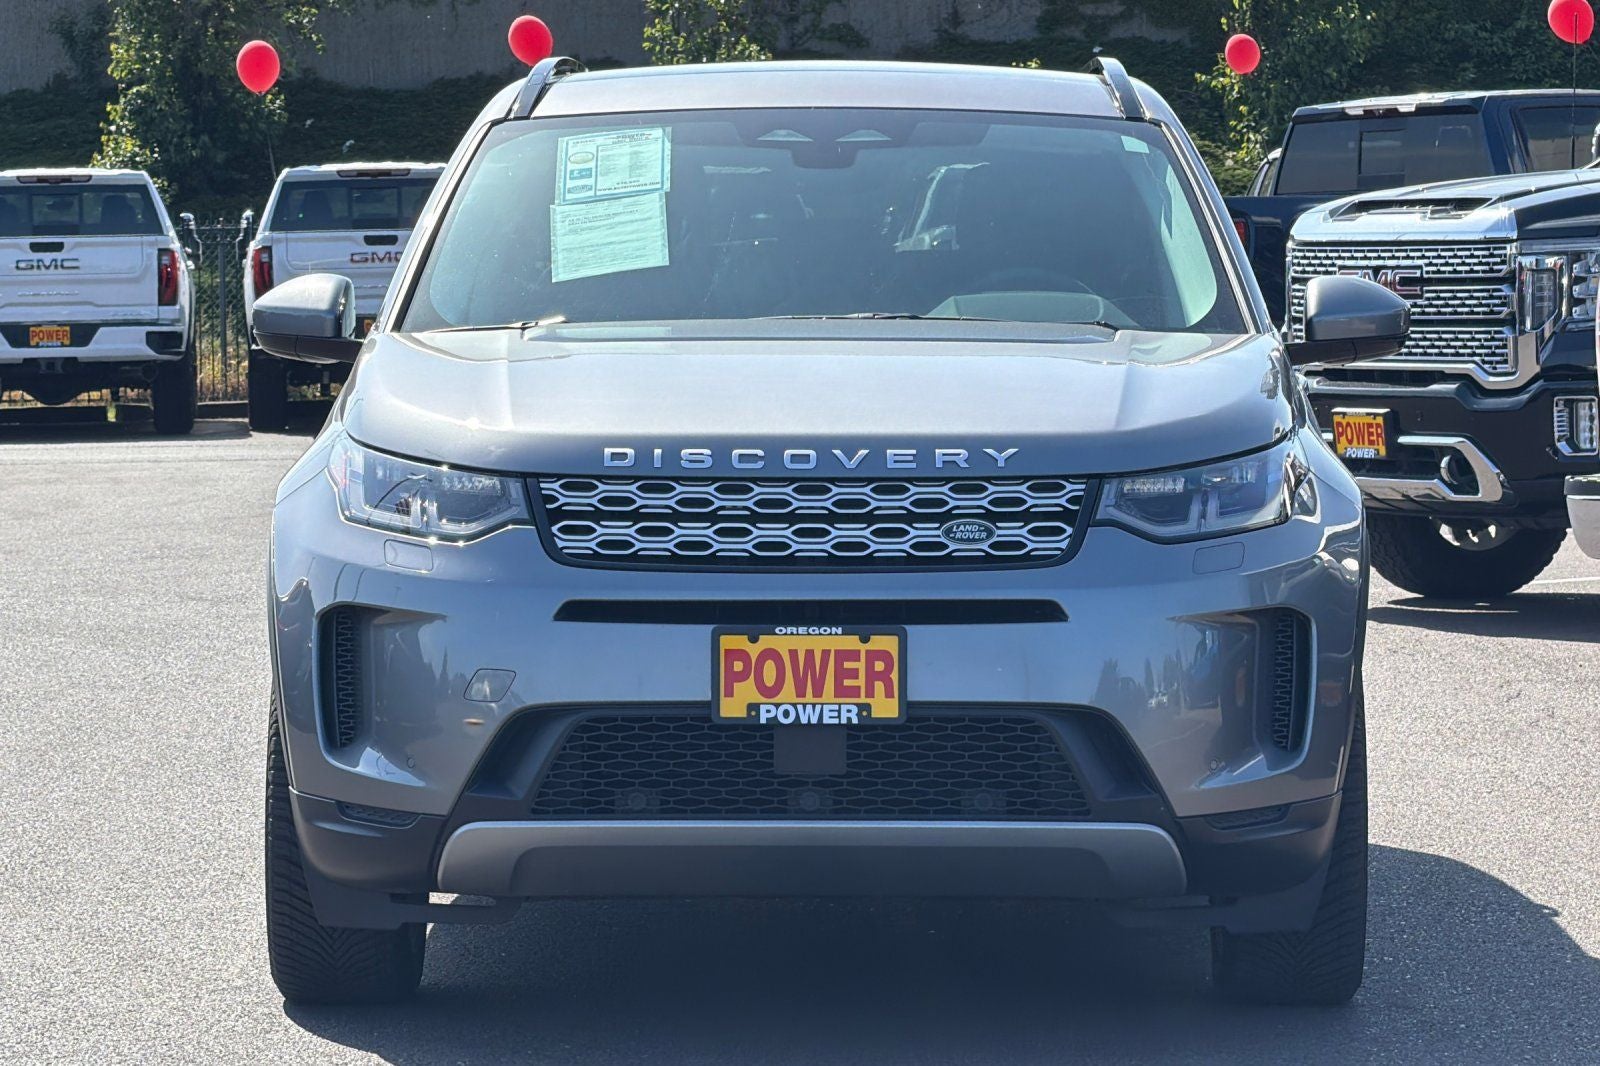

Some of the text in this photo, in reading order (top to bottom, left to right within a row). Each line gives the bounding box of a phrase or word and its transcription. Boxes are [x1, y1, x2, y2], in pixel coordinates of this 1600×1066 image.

[15, 258, 80, 271] GMC
[31, 329, 69, 341] POWER
[1336, 421, 1384, 446] POWER
[603, 447, 1019, 469] DISCOVERY
[1346, 447, 1375, 458] POWER
[774, 626, 842, 635] OREGON
[723, 647, 895, 699] POWER
[759, 703, 859, 724] POWER
